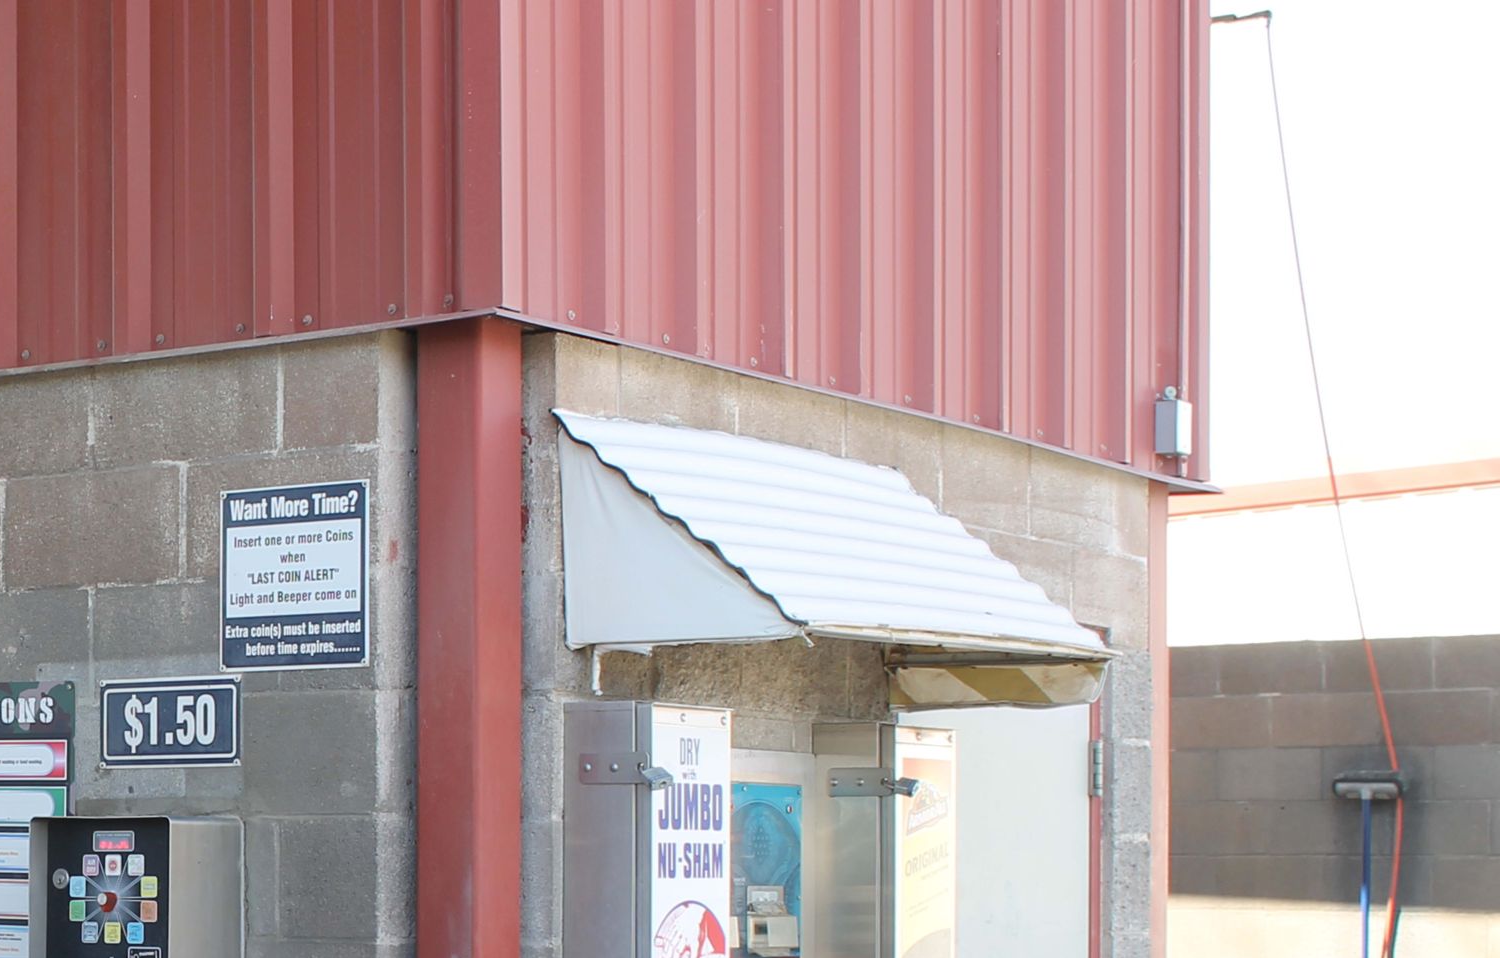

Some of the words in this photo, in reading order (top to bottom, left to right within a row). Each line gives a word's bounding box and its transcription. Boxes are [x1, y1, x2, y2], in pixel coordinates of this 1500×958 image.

[230, 498, 267, 521] Want
[271, 496, 309, 518] More
[312, 490, 358, 515] Time?
[234, 536, 262, 548] Insert
[265, 536, 282, 546] one
[285, 536, 295, 545] or
[298, 532, 322, 544] more
[326, 529, 354, 542] Coins
[280, 551, 305, 563] when
[248, 571, 275, 585] "LAST
[278, 570, 301, 583] COIN
[304, 568, 339, 581] ALERT"
[230, 594, 255, 608] Light
[257, 591, 275, 604] and
[278, 590, 311, 605] Beeper
[315, 589, 341, 600] come
[345, 589, 357, 599] on
[225, 625, 248, 639] Extra
[251, 623, 281, 639] coin(s)
[283, 622, 306, 635] must
[308, 621, 319, 634] be
[322, 619, 361, 633] inserted
[246, 642, 275, 656] before
[277, 641, 298, 655] time
[124, 694, 215, 753] $1.50
[680, 737, 700, 765] DRY
[682, 769, 697, 779] with
[658, 783, 723, 831] JUMBO
[658, 842, 723, 879] NU-SHAM
[905, 842, 949, 877] ORIGINAL
